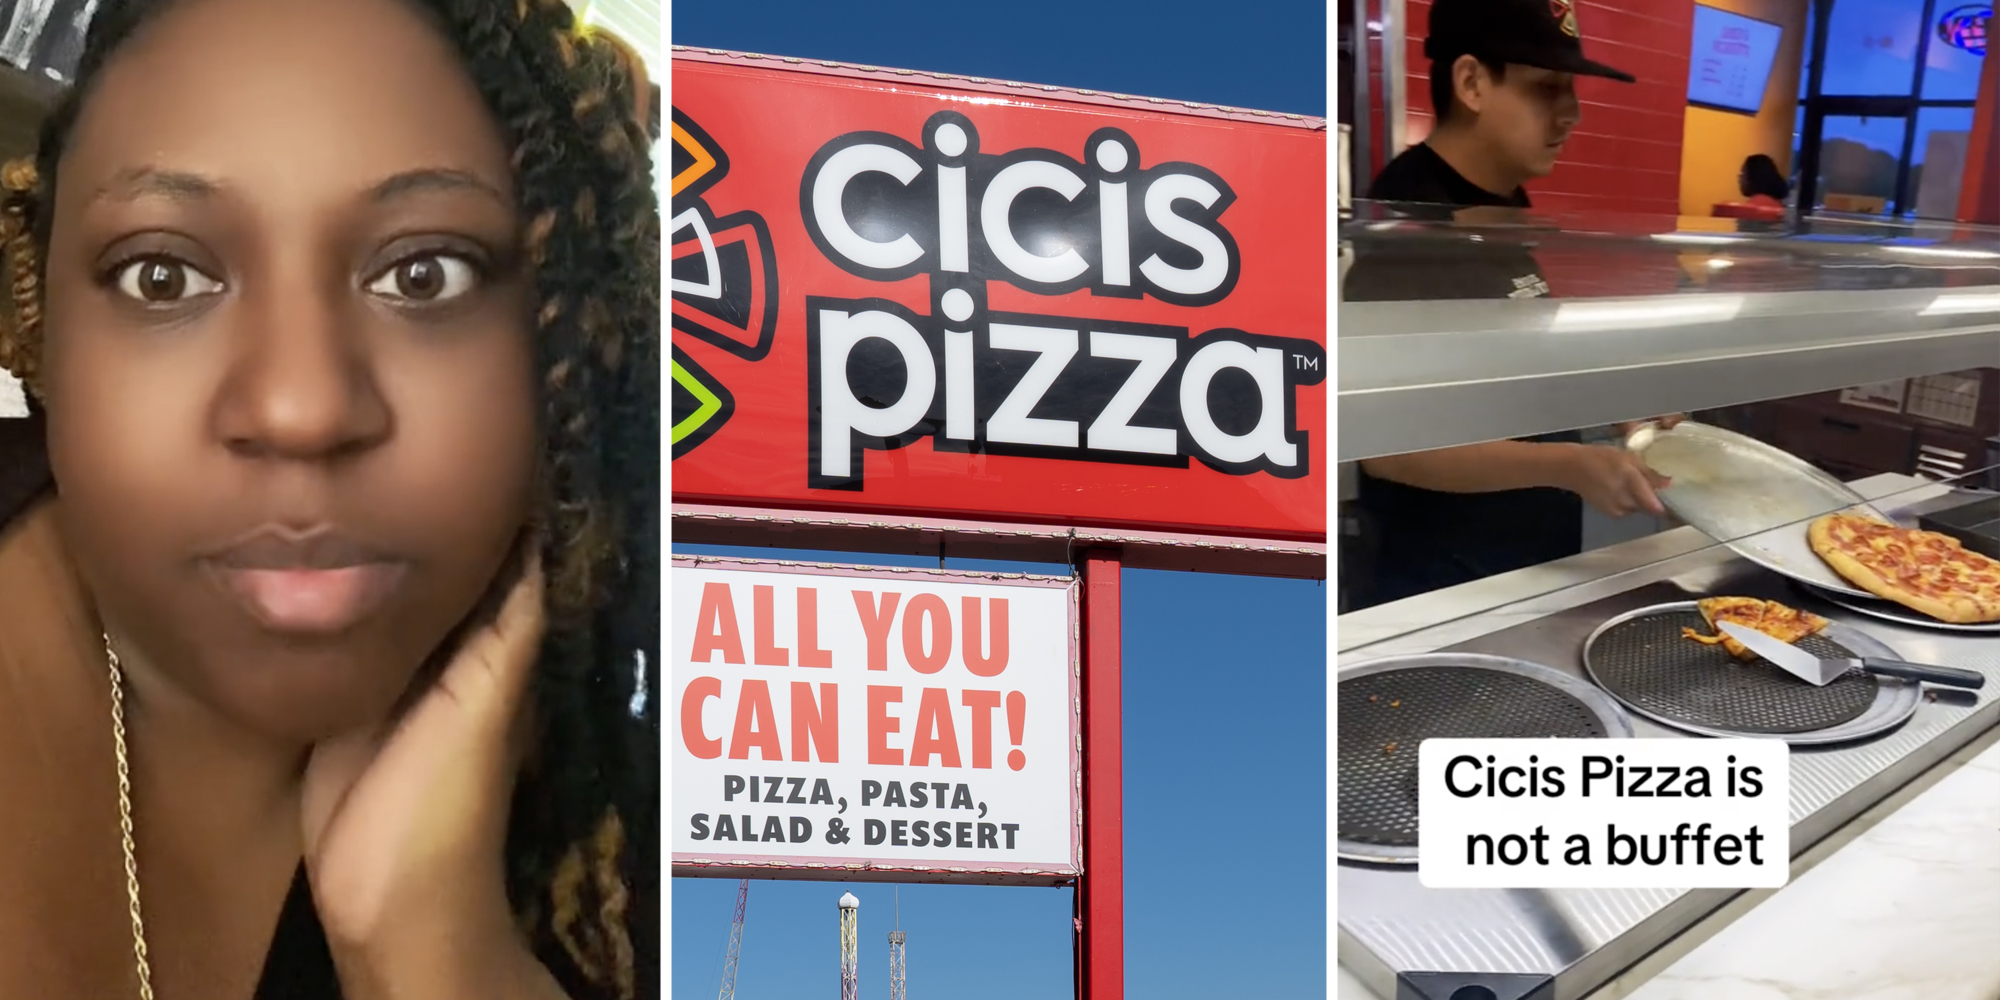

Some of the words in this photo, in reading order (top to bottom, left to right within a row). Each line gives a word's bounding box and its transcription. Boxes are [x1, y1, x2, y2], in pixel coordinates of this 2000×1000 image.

[811, 122, 1230, 295] cicis
[818, 287, 1298, 478] pizza
[1292, 354, 1319, 372] TM
[690, 582, 833, 669] ALL
[851, 590, 1011, 677] YOU
[680, 676, 839, 764] CAN
[866, 684, 1027, 772] EAT!
[690, 812, 813, 844] SALAD
[825, 817, 851, 845] &
[863, 818, 1020, 850] DESSERT
[723, 774, 848, 815] PIZZA,
[861, 779, 988, 819] PASTA,
